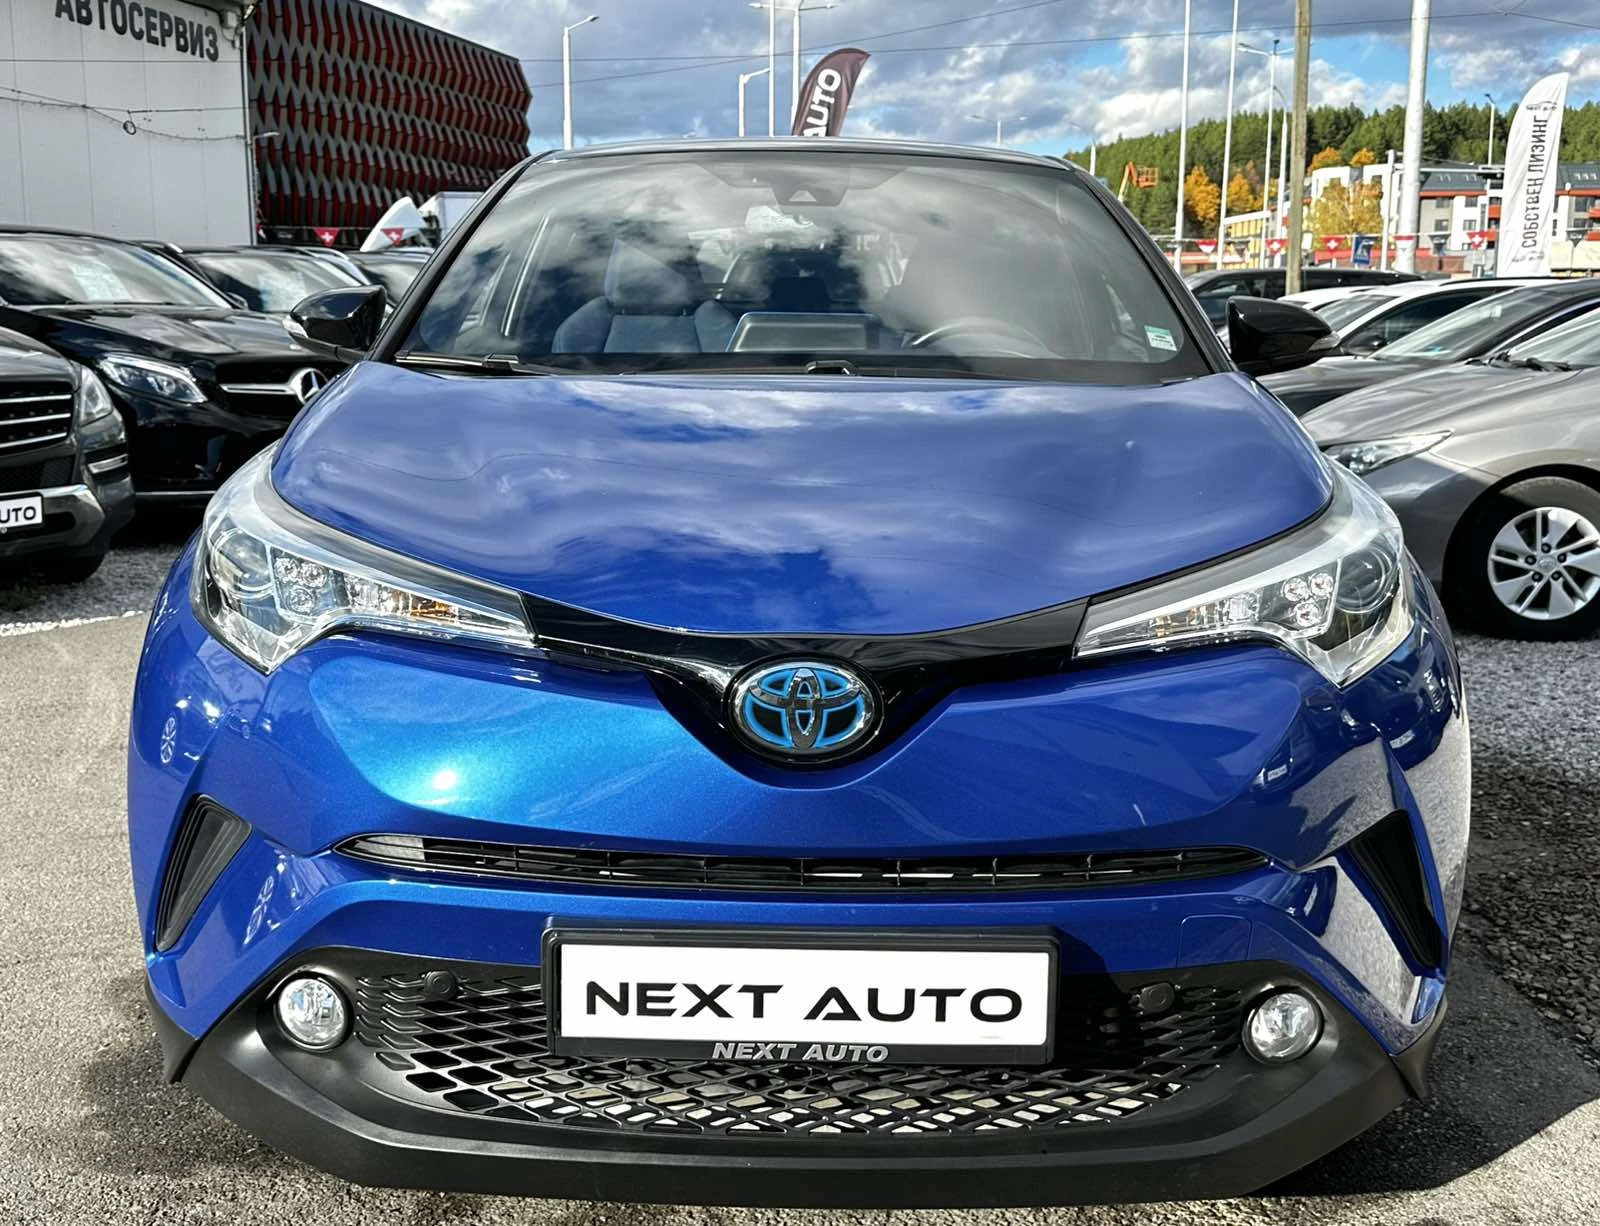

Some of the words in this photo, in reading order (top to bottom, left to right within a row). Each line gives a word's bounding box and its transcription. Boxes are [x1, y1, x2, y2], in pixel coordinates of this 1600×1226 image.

[55, 0, 219, 62] АВТОСЕРВИЗ
[1527, 115, 1548, 173] ЛИЗИНГ
[1521, 178, 1544, 249] СОБСТВЕН
[586, 980, 784, 1018] NEXT
[803, 986, 1022, 1023] AUTO
[711, 1042, 798, 1061] NEXT
[801, 1043, 889, 1063] AUTO
